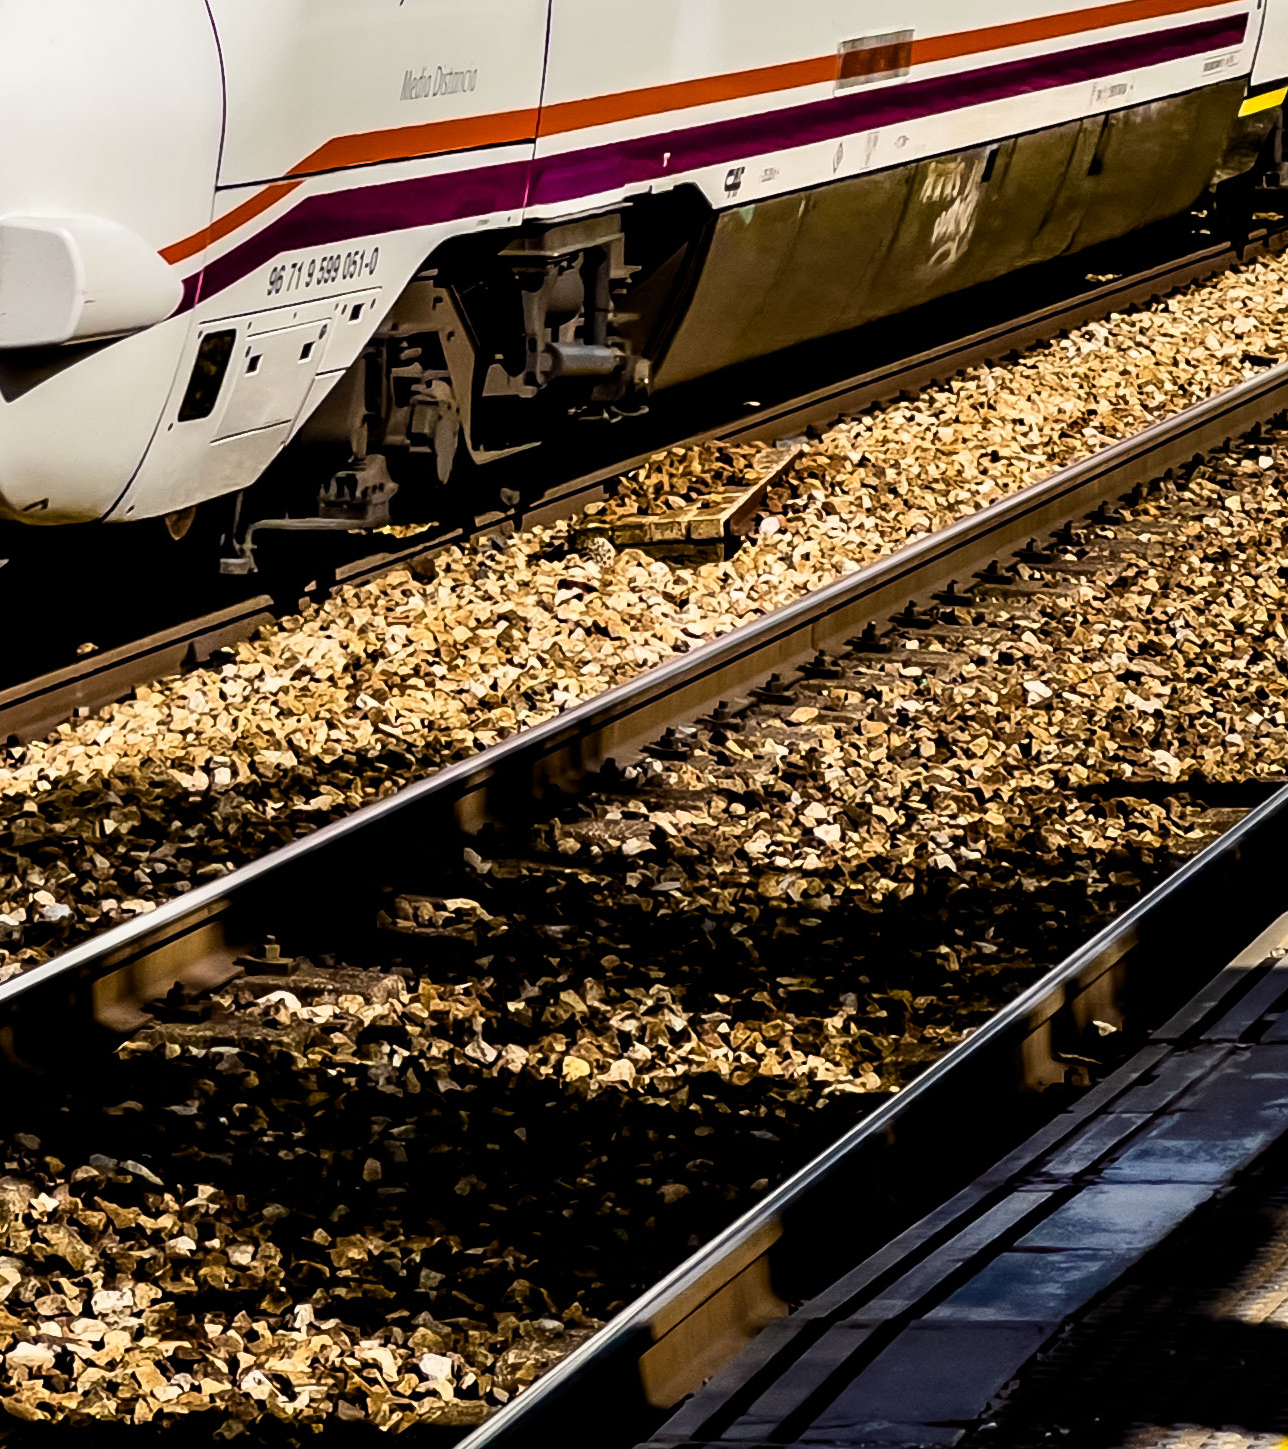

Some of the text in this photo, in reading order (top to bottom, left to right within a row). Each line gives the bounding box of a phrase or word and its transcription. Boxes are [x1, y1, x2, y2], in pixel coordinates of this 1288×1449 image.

[399, 63, 478, 101] Media Distancia
[267, 246, 379, 296] 96 71 9 599 051-0
